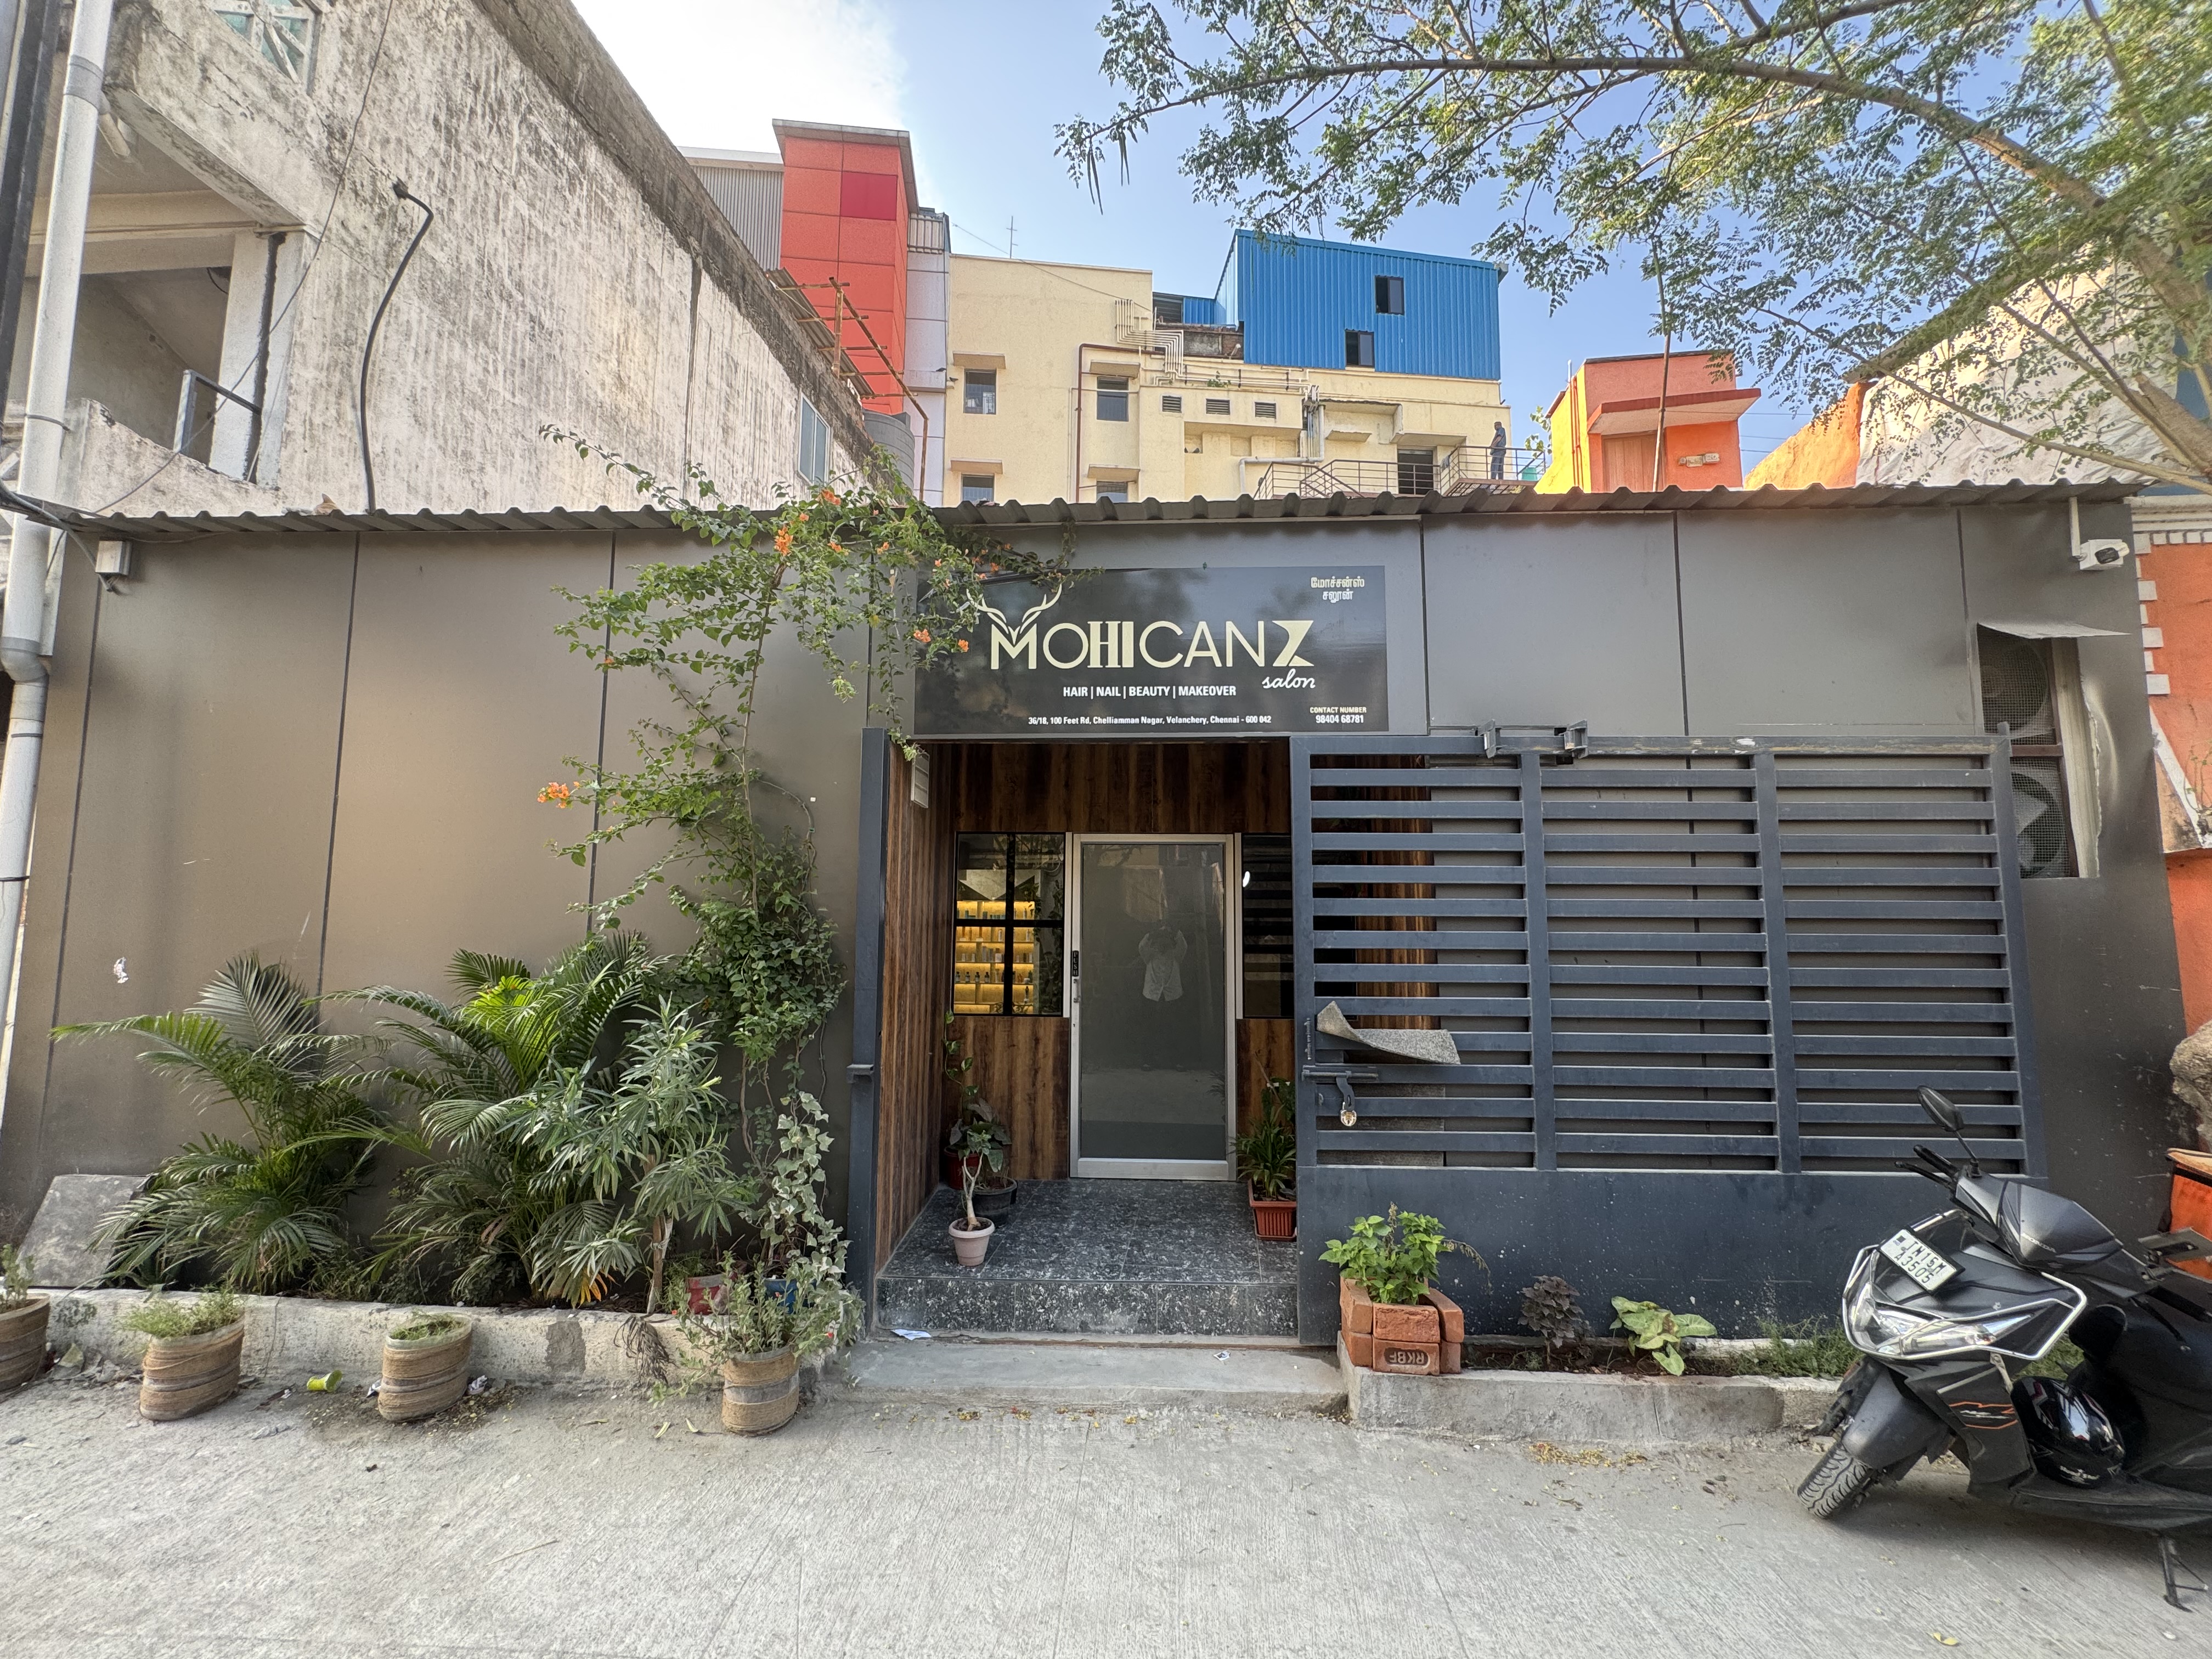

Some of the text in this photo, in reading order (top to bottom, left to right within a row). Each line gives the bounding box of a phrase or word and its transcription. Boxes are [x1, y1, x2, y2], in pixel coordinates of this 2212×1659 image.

[1322, 588, 1354, 603] சலூன்
[990, 620, 1314, 670] MOHICANZ
[1262, 668, 1316, 689] salon
[1063, 686, 1088, 697] HAIR
[1096, 686, 1121, 697] NAIL
[1128, 686, 1171, 697] BEAUTY
[1178, 685, 1237, 696] MAKEOVER
[1028, 716, 1049, 725] 36/18,
[1050, 716, 1062, 725] 100
[1080, 716, 1092, 725] Rd,
[1093, 716, 1139, 724] Chelliamman
[1141, 716, 1165, 725] Nagar,
[1166, 716, 1209, 725] Velanchery,
[1210, 715, 1240, 724] Chennai
[1245, 715, 1258, 724] 600
[1259, 715, 1272, 724] 042
[1315, 714, 1364, 724] 98404 68781
[1906, 1240, 1947, 1274] TN15M
[1894, 1251, 1934, 1283] A3505
[1389, 1351, 1425, 1364] RKBF
